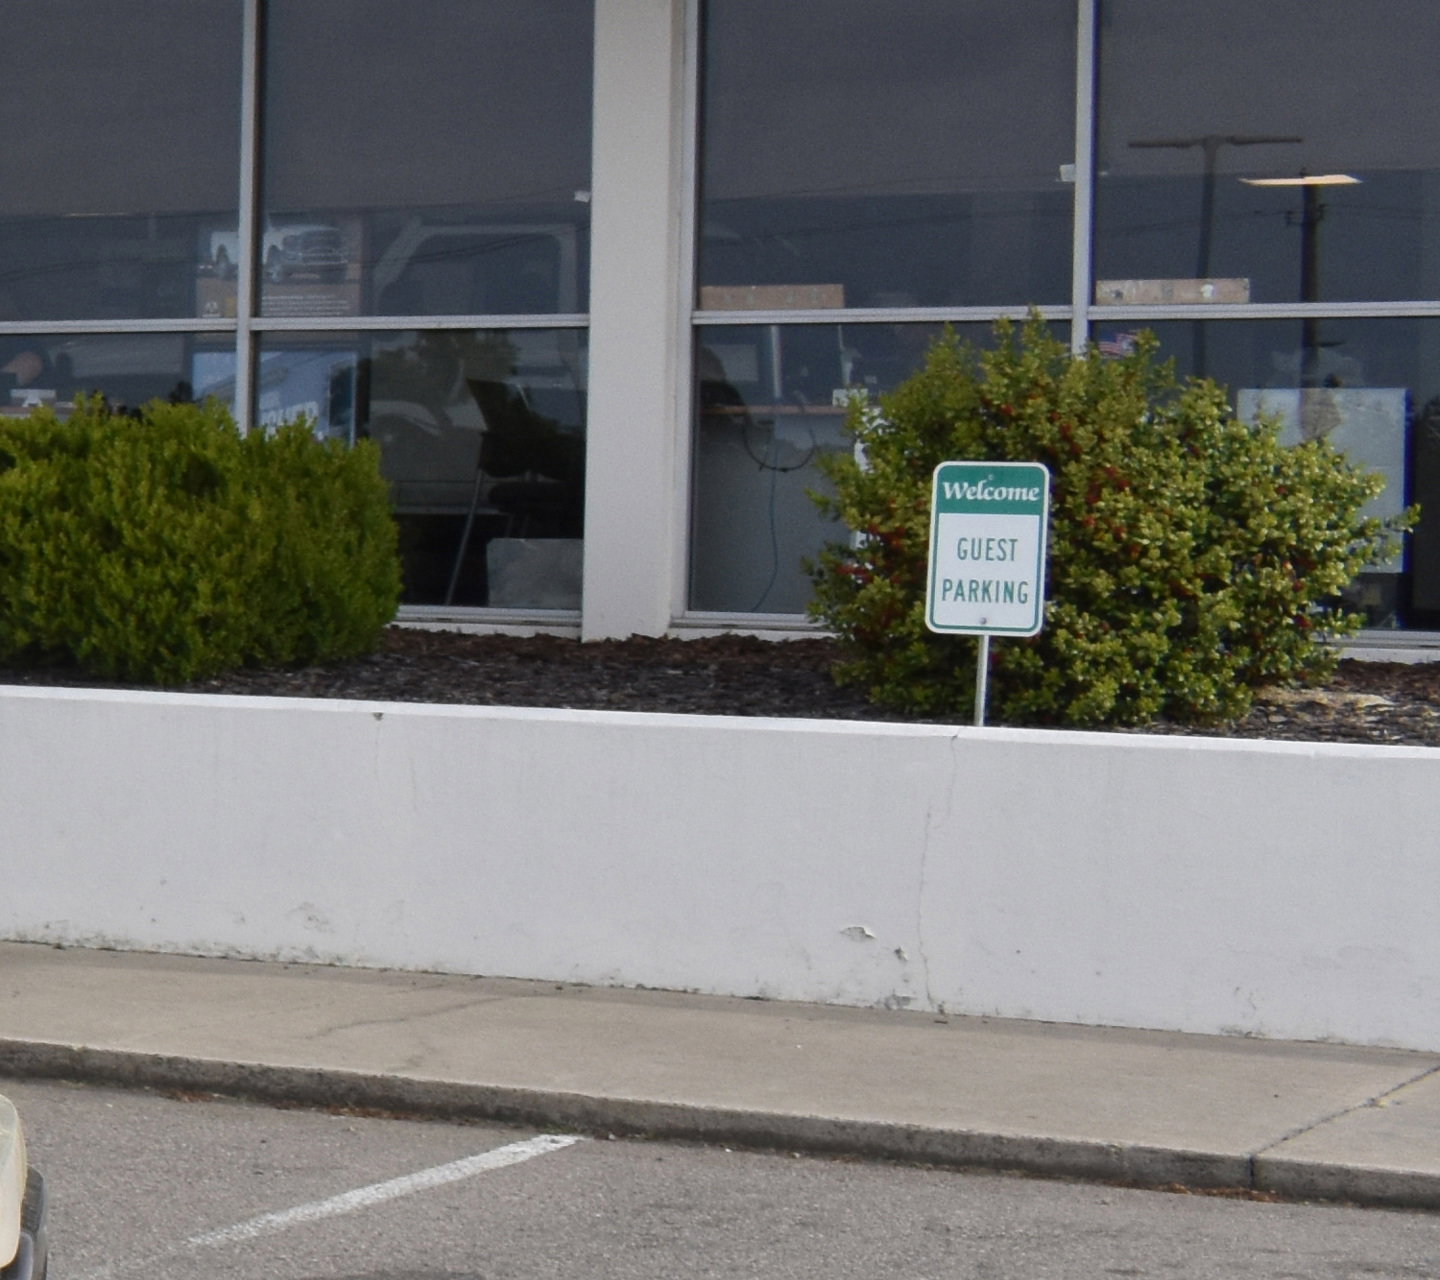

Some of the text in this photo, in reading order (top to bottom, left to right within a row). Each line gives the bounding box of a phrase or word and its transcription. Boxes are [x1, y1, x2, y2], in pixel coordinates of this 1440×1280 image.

[942, 479, 1040, 501] Welcome
[957, 537, 1018, 561] GUEST
[941, 578, 1029, 604] PARKING
